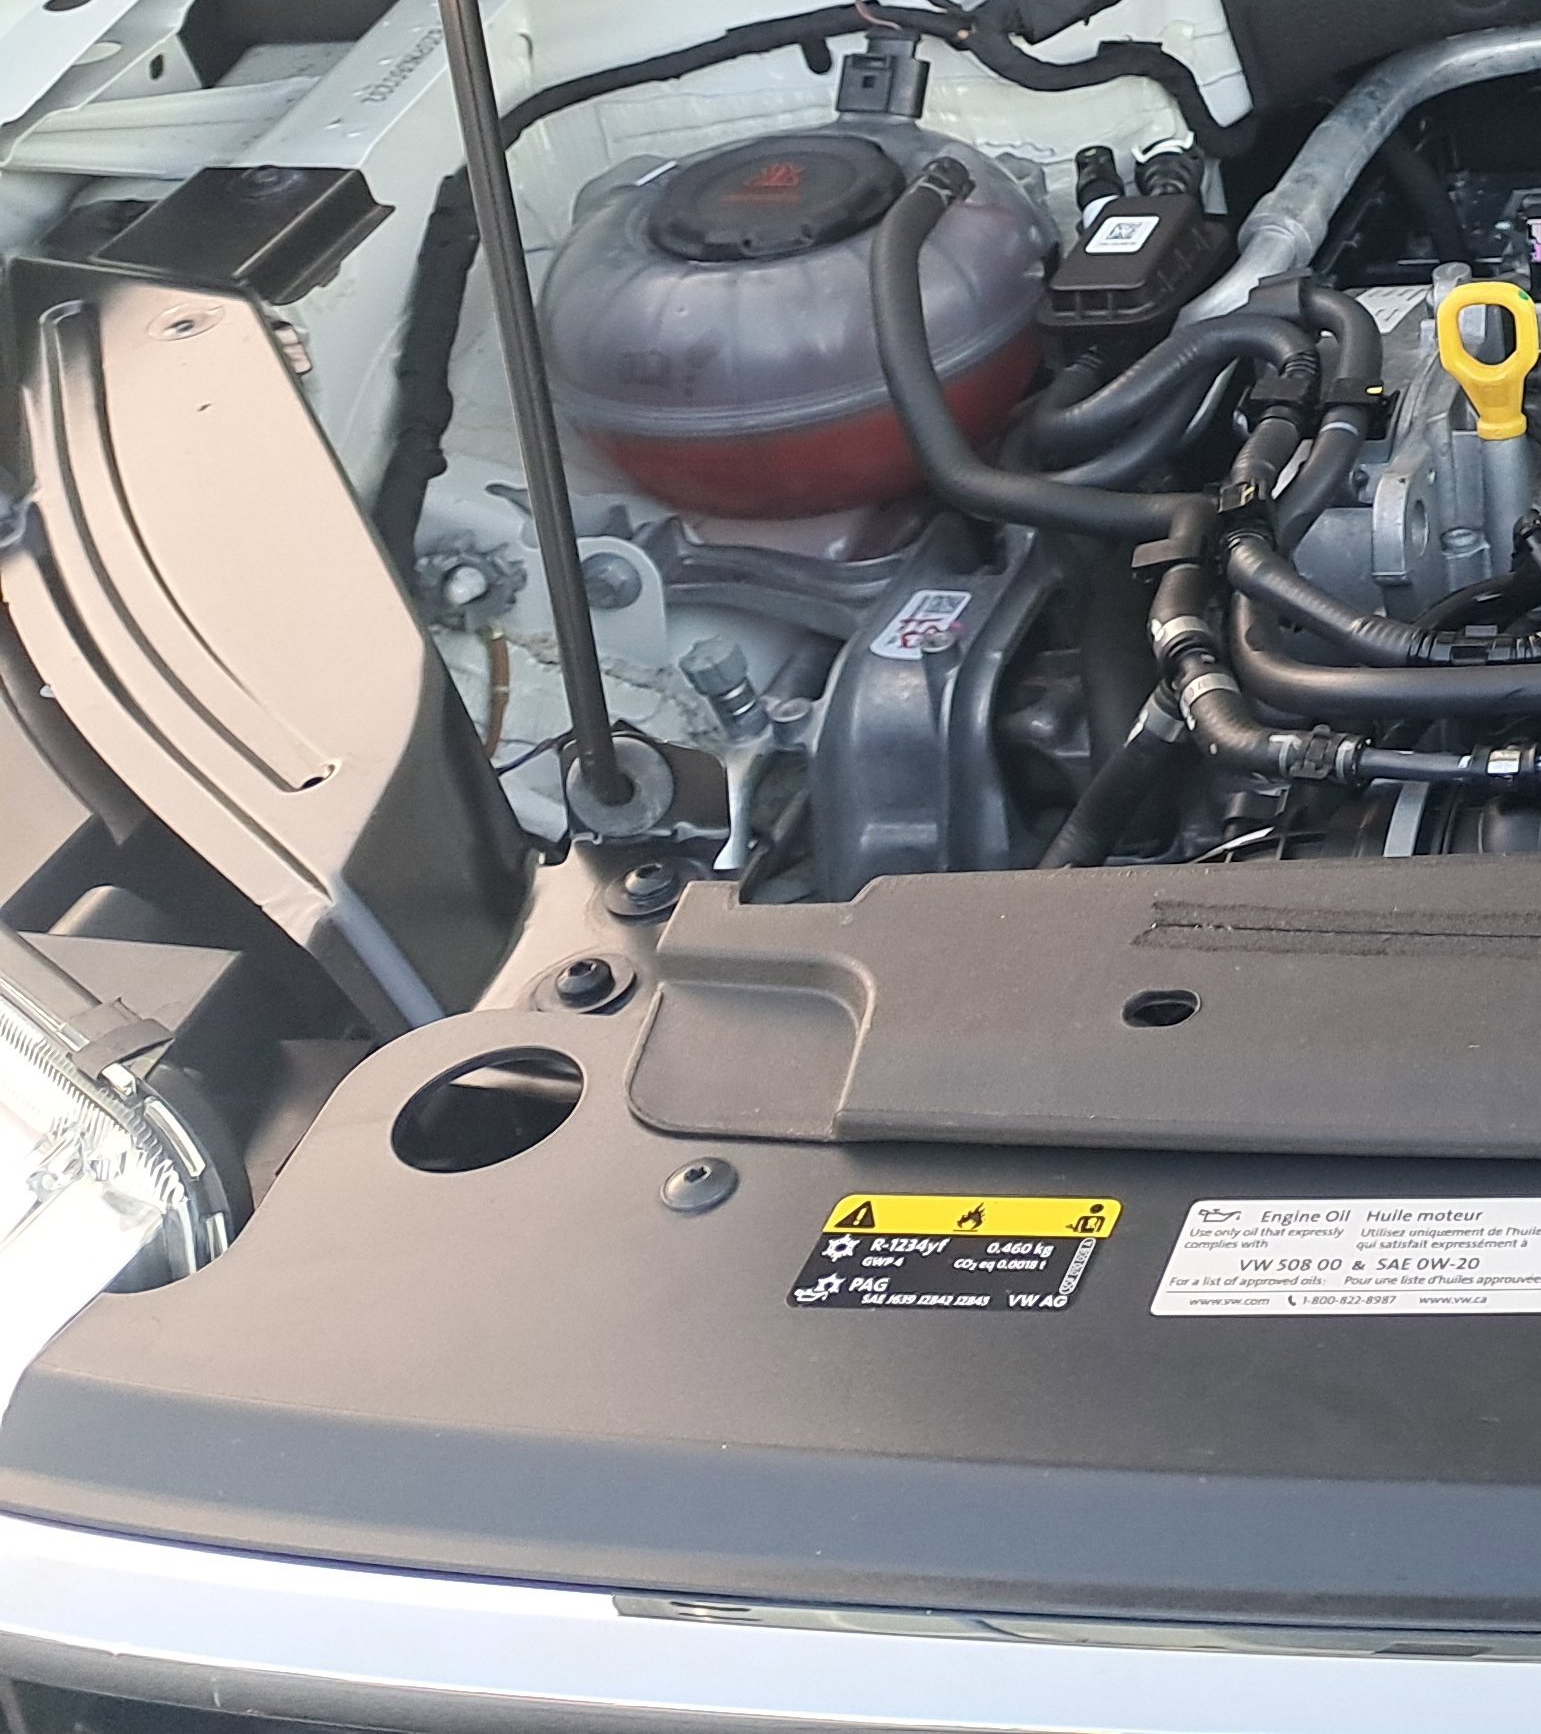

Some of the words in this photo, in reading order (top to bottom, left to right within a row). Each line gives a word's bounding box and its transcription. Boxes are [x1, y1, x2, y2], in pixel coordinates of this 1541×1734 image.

[1261, 1210, 1321, 1226] Engine
[1325, 1209, 1351, 1223] Oil
[1366, 1209, 1413, 1222] Huile
[1416, 1210, 1484, 1222] moteur
[1190, 1228, 1212, 1237] Use
[1214, 1227, 1241, 1240] only
[1243, 1227, 1259, 1237] oil
[1260, 1227, 1286, 1237] that
[1288, 1227, 1344, 1240] expressly
[1360, 1227, 1405, 1237] Utilisez
[1408, 1227, 1486, 1240] uniquement
[1487, 1227, 1504, 1236] de
[870, 1237, 950, 1255] R-1234yf
[986, 1241, 1031, 1255] 0.460
[1034, 1243, 1055, 1258] kg
[1184, 1240, 1239, 1251] complies
[1241, 1239, 1269, 1249] with
[1356, 1239, 1377, 1251] qui
[1379, 1239, 1428, 1249] satisfait
[1430, 1238, 1517, 1251] expressément
[1520, 1239, 1528, 1248] à
[1239, 1258, 1274, 1271] VW
[1275, 1258, 1312, 1271] 508
[1317, 1258, 1343, 1270] 00
[1351, 1260, 1366, 1270] &
[1376, 1258, 1412, 1270] SAE
[1416, 1257, 1481, 1270] 0W-20
[848, 1277, 891, 1292] PAG
[1169, 1276, 1189, 1286] For
[1202, 1276, 1221, 1286] list
[1223, 1276, 1239, 1286] of
[1239, 1276, 1298, 1288] approved
[1344, 1275, 1372, 1285] Pour
[1374, 1276, 1398, 1285] une
[1401, 1275, 1426, 1285] liste
[1007, 1294, 1038, 1308] VW
[1039, 1295, 1069, 1308] AG
[1303, 1295, 1397, 1306] 1-800-822-8987
